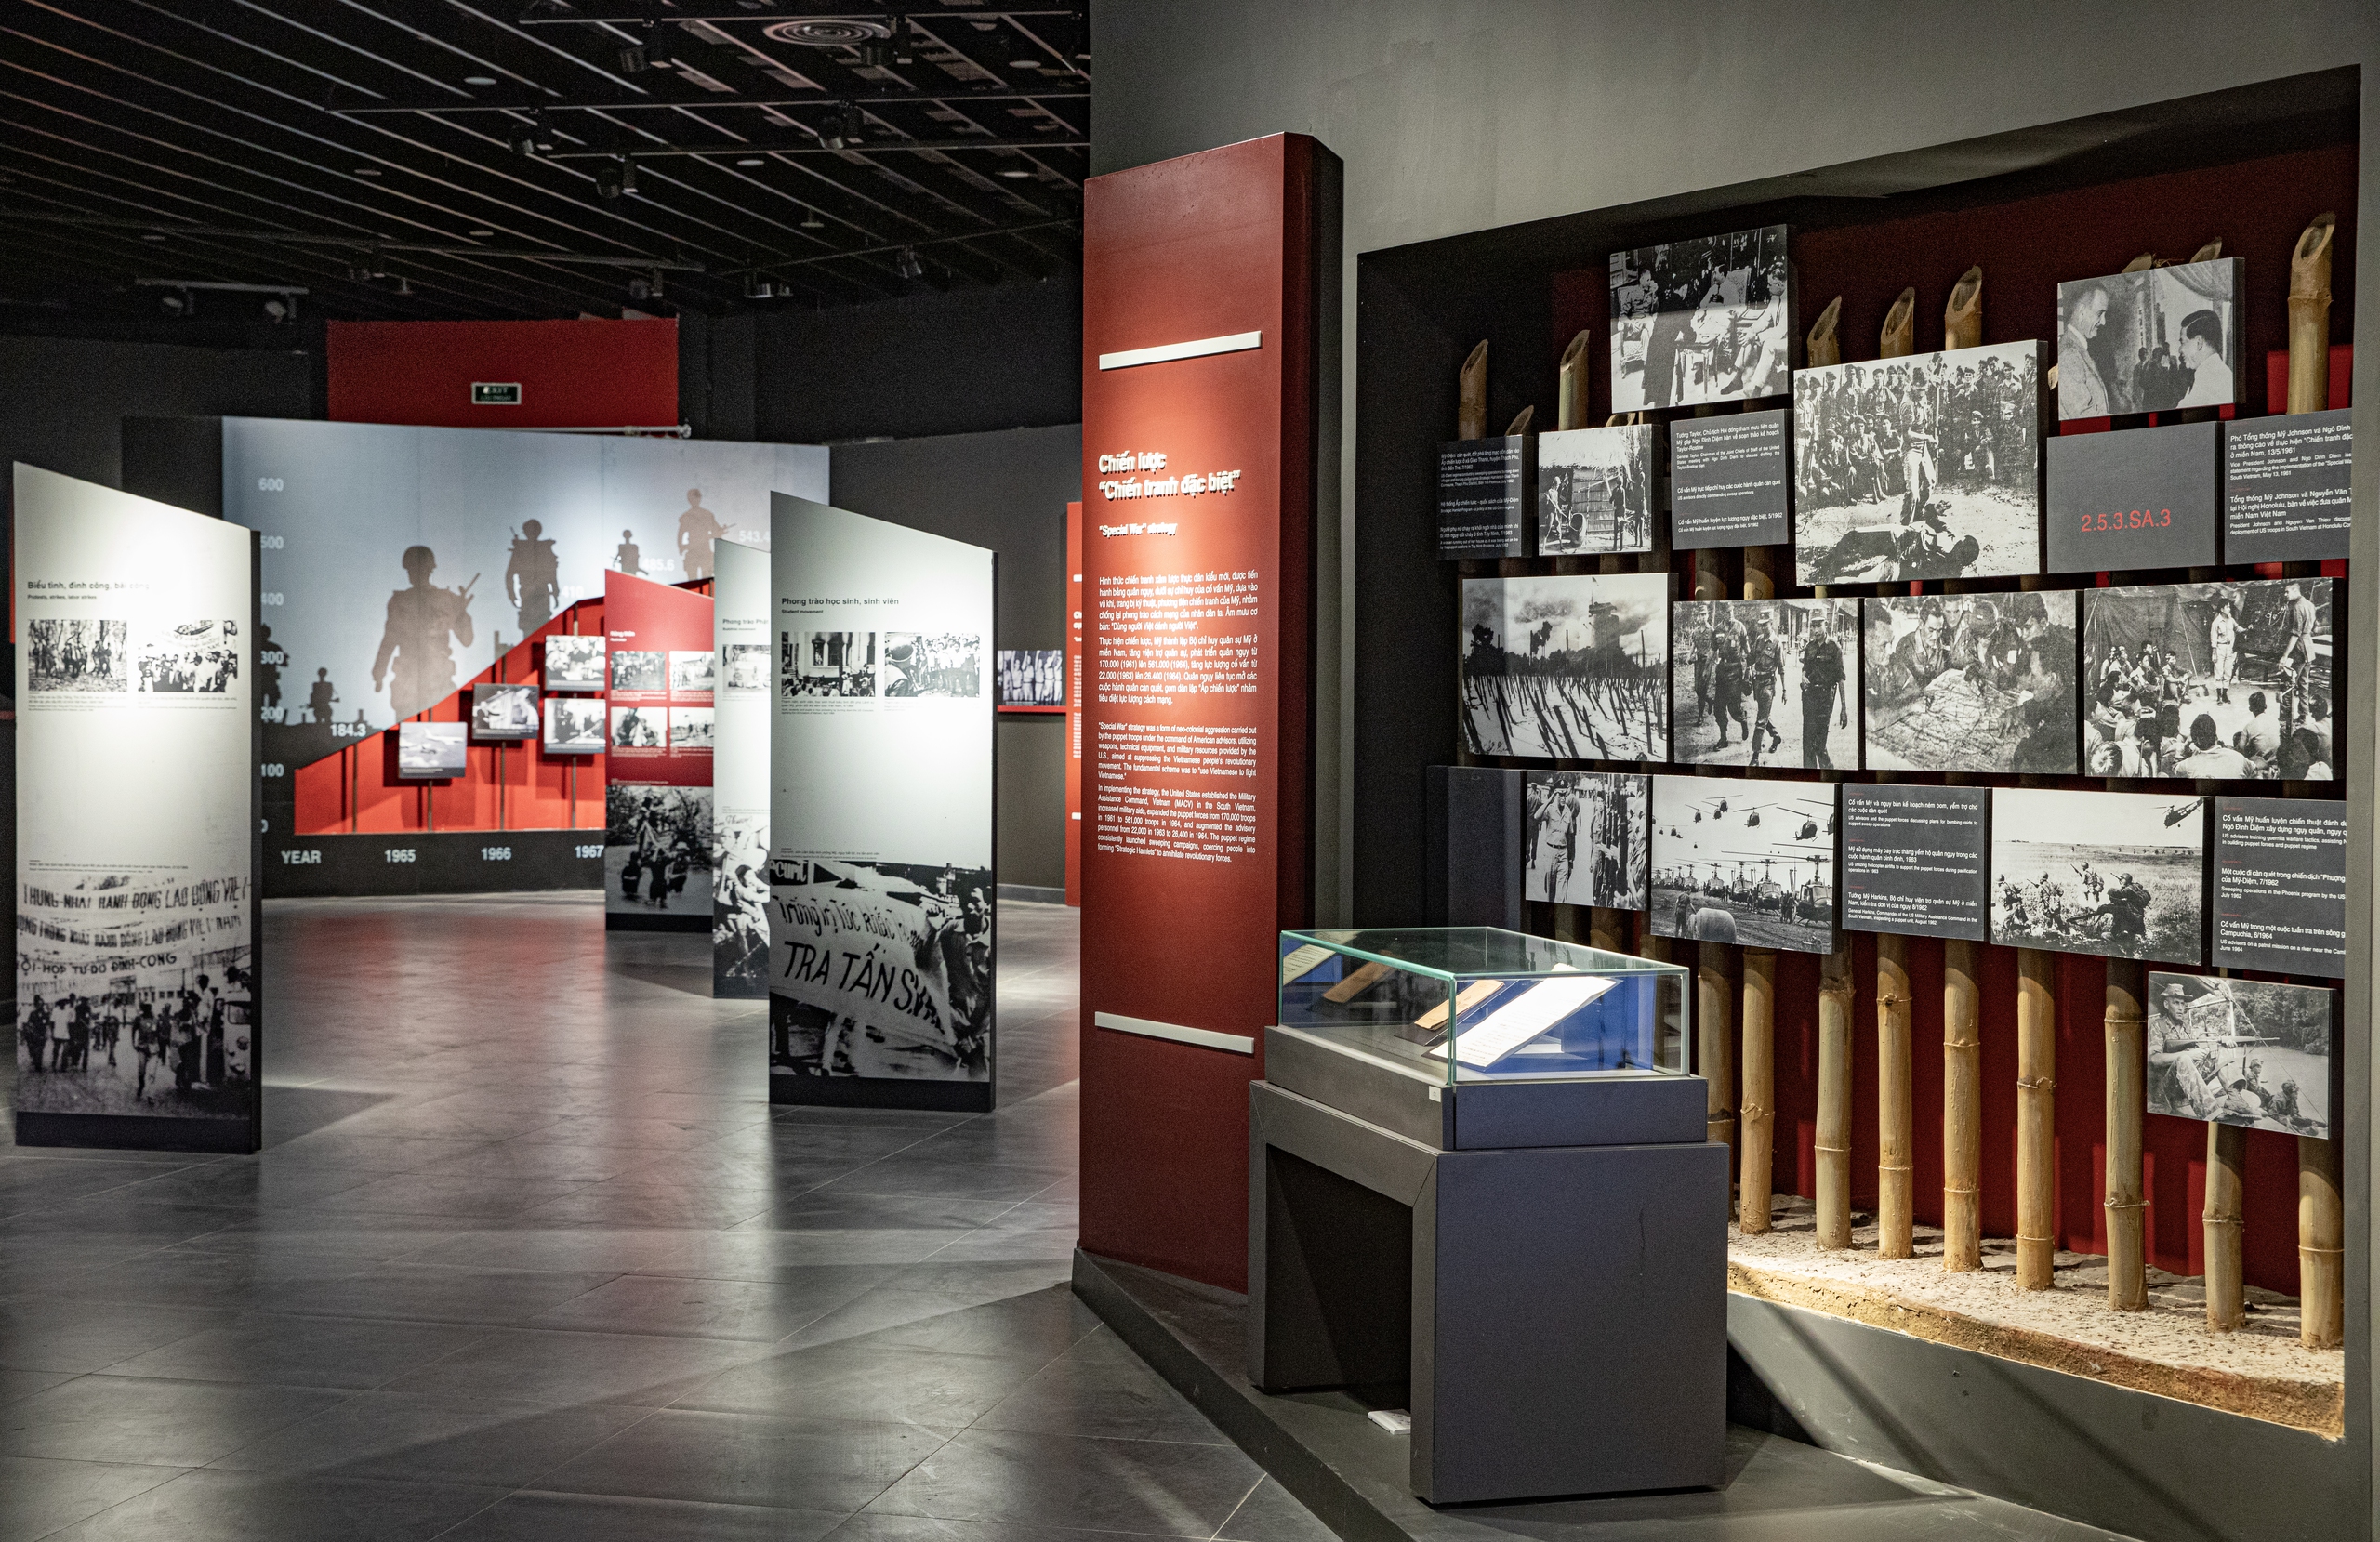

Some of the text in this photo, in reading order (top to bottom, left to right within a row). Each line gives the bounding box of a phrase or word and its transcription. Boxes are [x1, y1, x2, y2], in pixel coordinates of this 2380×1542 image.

[2244, 432, 2258, 442] Tổng
[2259, 430, 2276, 440] thống
[2277, 430, 2286, 439] Mỹ
[2287, 427, 2313, 436] Johnson
[2322, 425, 2335, 434] Ngô
[2237, 441, 2254, 451] thông
[2275, 438, 2288, 447] thực
[2289, 437, 2302, 446] hiện
[2304, 434, 2324, 443] "Chiến
[2342, 432, 2353, 441] đặc
[2235, 449, 2249, 458] miền
[2250, 449, 2266, 457] Nam,
[2268, 445, 2295, 455] 13/5/1961
[1099, 451, 1166, 473] Chiến lược
[258, 478, 284, 491] 600
[1144, 476, 1178, 496] tranh
[1181, 474, 1206, 496] đặc
[2230, 494, 2245, 504] Tổng
[2246, 493, 2263, 503] thống
[2264, 493, 2273, 502] Mỹ
[2310, 488, 2333, 498] Nguyễn
[2238, 503, 2247, 512] Hội
[2248, 503, 2260, 511] nghị
[2260, 501, 2286, 510] Honolulu,
[2307, 498, 2319, 507] việc
[2331, 497, 2346, 505] quân
[2081, 509, 2171, 532] 2.5.3.SA.3
[2260, 510, 2272, 519] Việt
[1147, 522, 1177, 535] strategy
[28, 580, 46, 589] Biểu
[68, 581, 86, 589] đình
[561, 586, 584, 598] 410
[782, 598, 806, 606] Phong
[826, 598, 840, 607] học
[261, 652, 284, 664] 300
[261, 708, 284, 720] 200
[330, 724, 366, 736] 184.3
[261, 765, 284, 777] 100
[1125, 797, 1149, 805] Command,
[2271, 817, 2287, 825] luyện
[2307, 818, 2322, 826] thuật
[281, 851, 321, 864] YEAR
[384, 849, 416, 863] 1965
[481, 847, 511, 860] 1966
[575, 845, 604, 858] 1967
[2232, 876, 2258, 885] Mỹ-Diệm,
[2221, 929, 2272, 939] Campuchia, 6/1964
[784, 941, 830, 985] TRA
[839, 944, 895, 1002] TẤN
